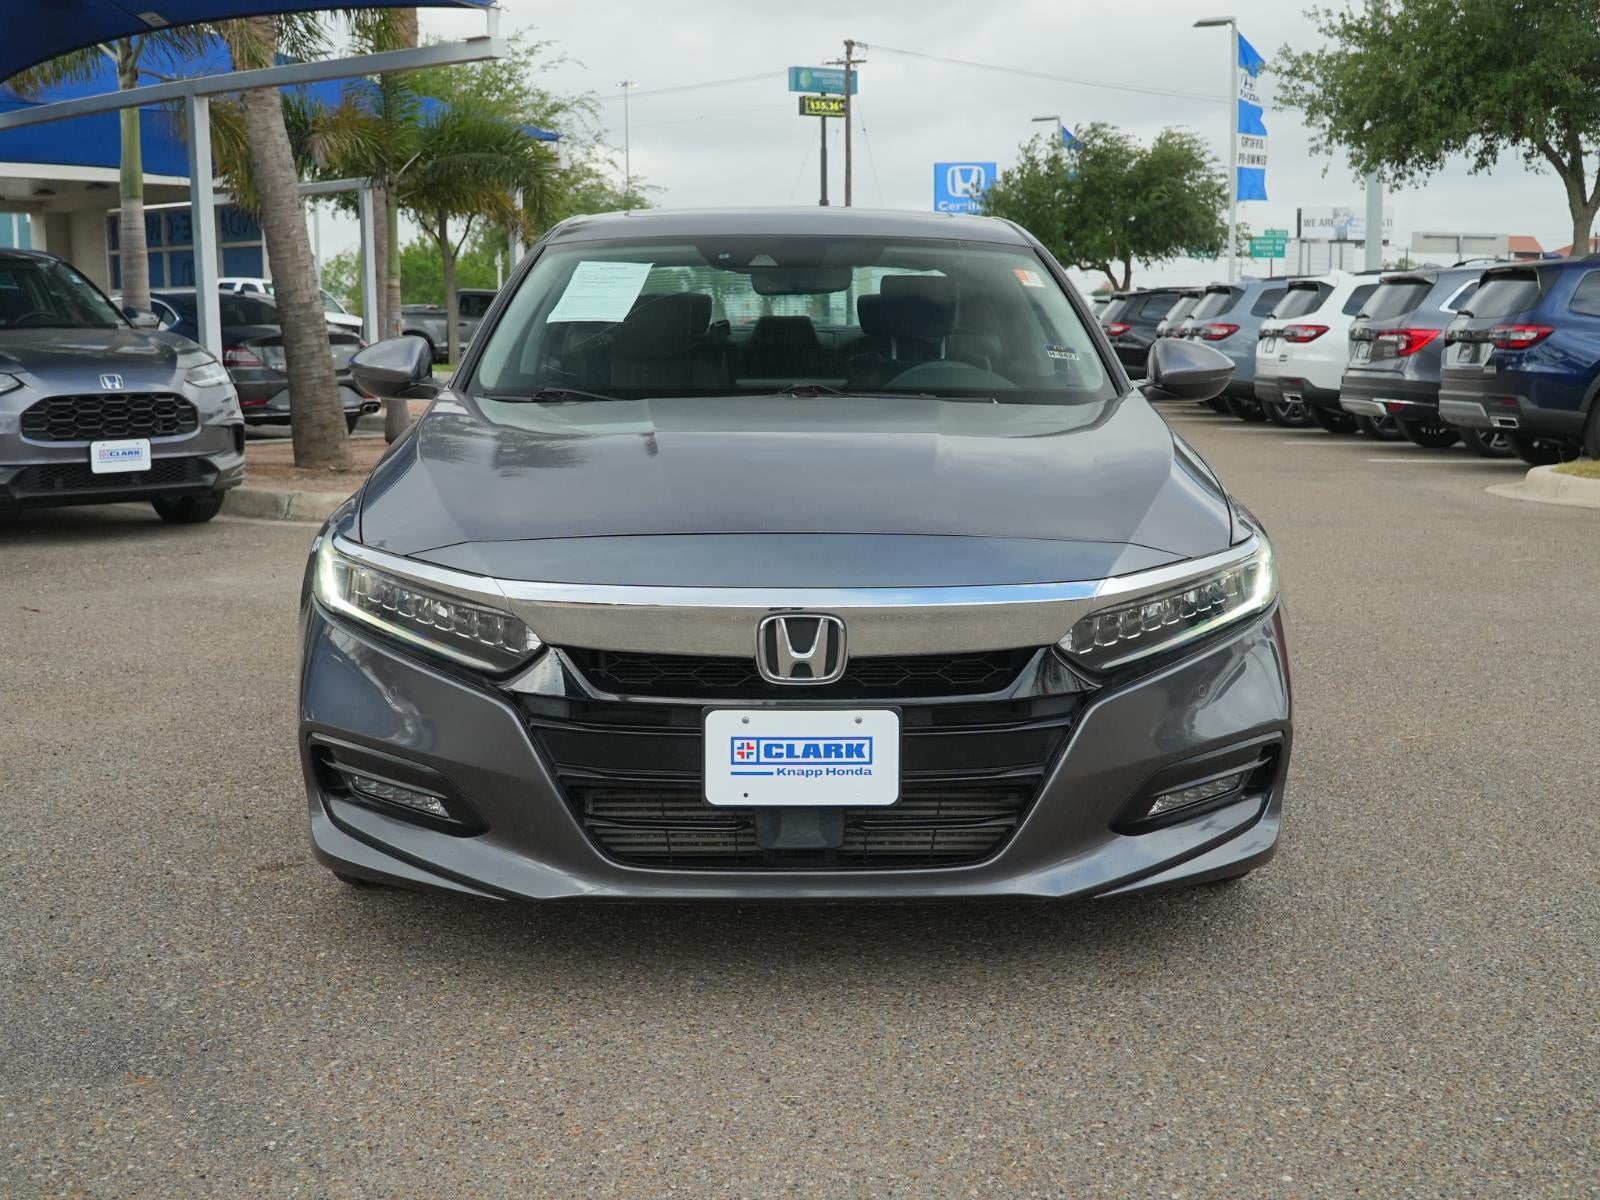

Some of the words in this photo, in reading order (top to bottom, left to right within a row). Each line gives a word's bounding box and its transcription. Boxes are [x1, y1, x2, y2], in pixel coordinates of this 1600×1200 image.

[1303, 218, 1318, 228] WE
[763, 743, 866, 759] CLARK
[776, 767, 823, 778] Knapp
[825, 767, 873, 776] Honda
